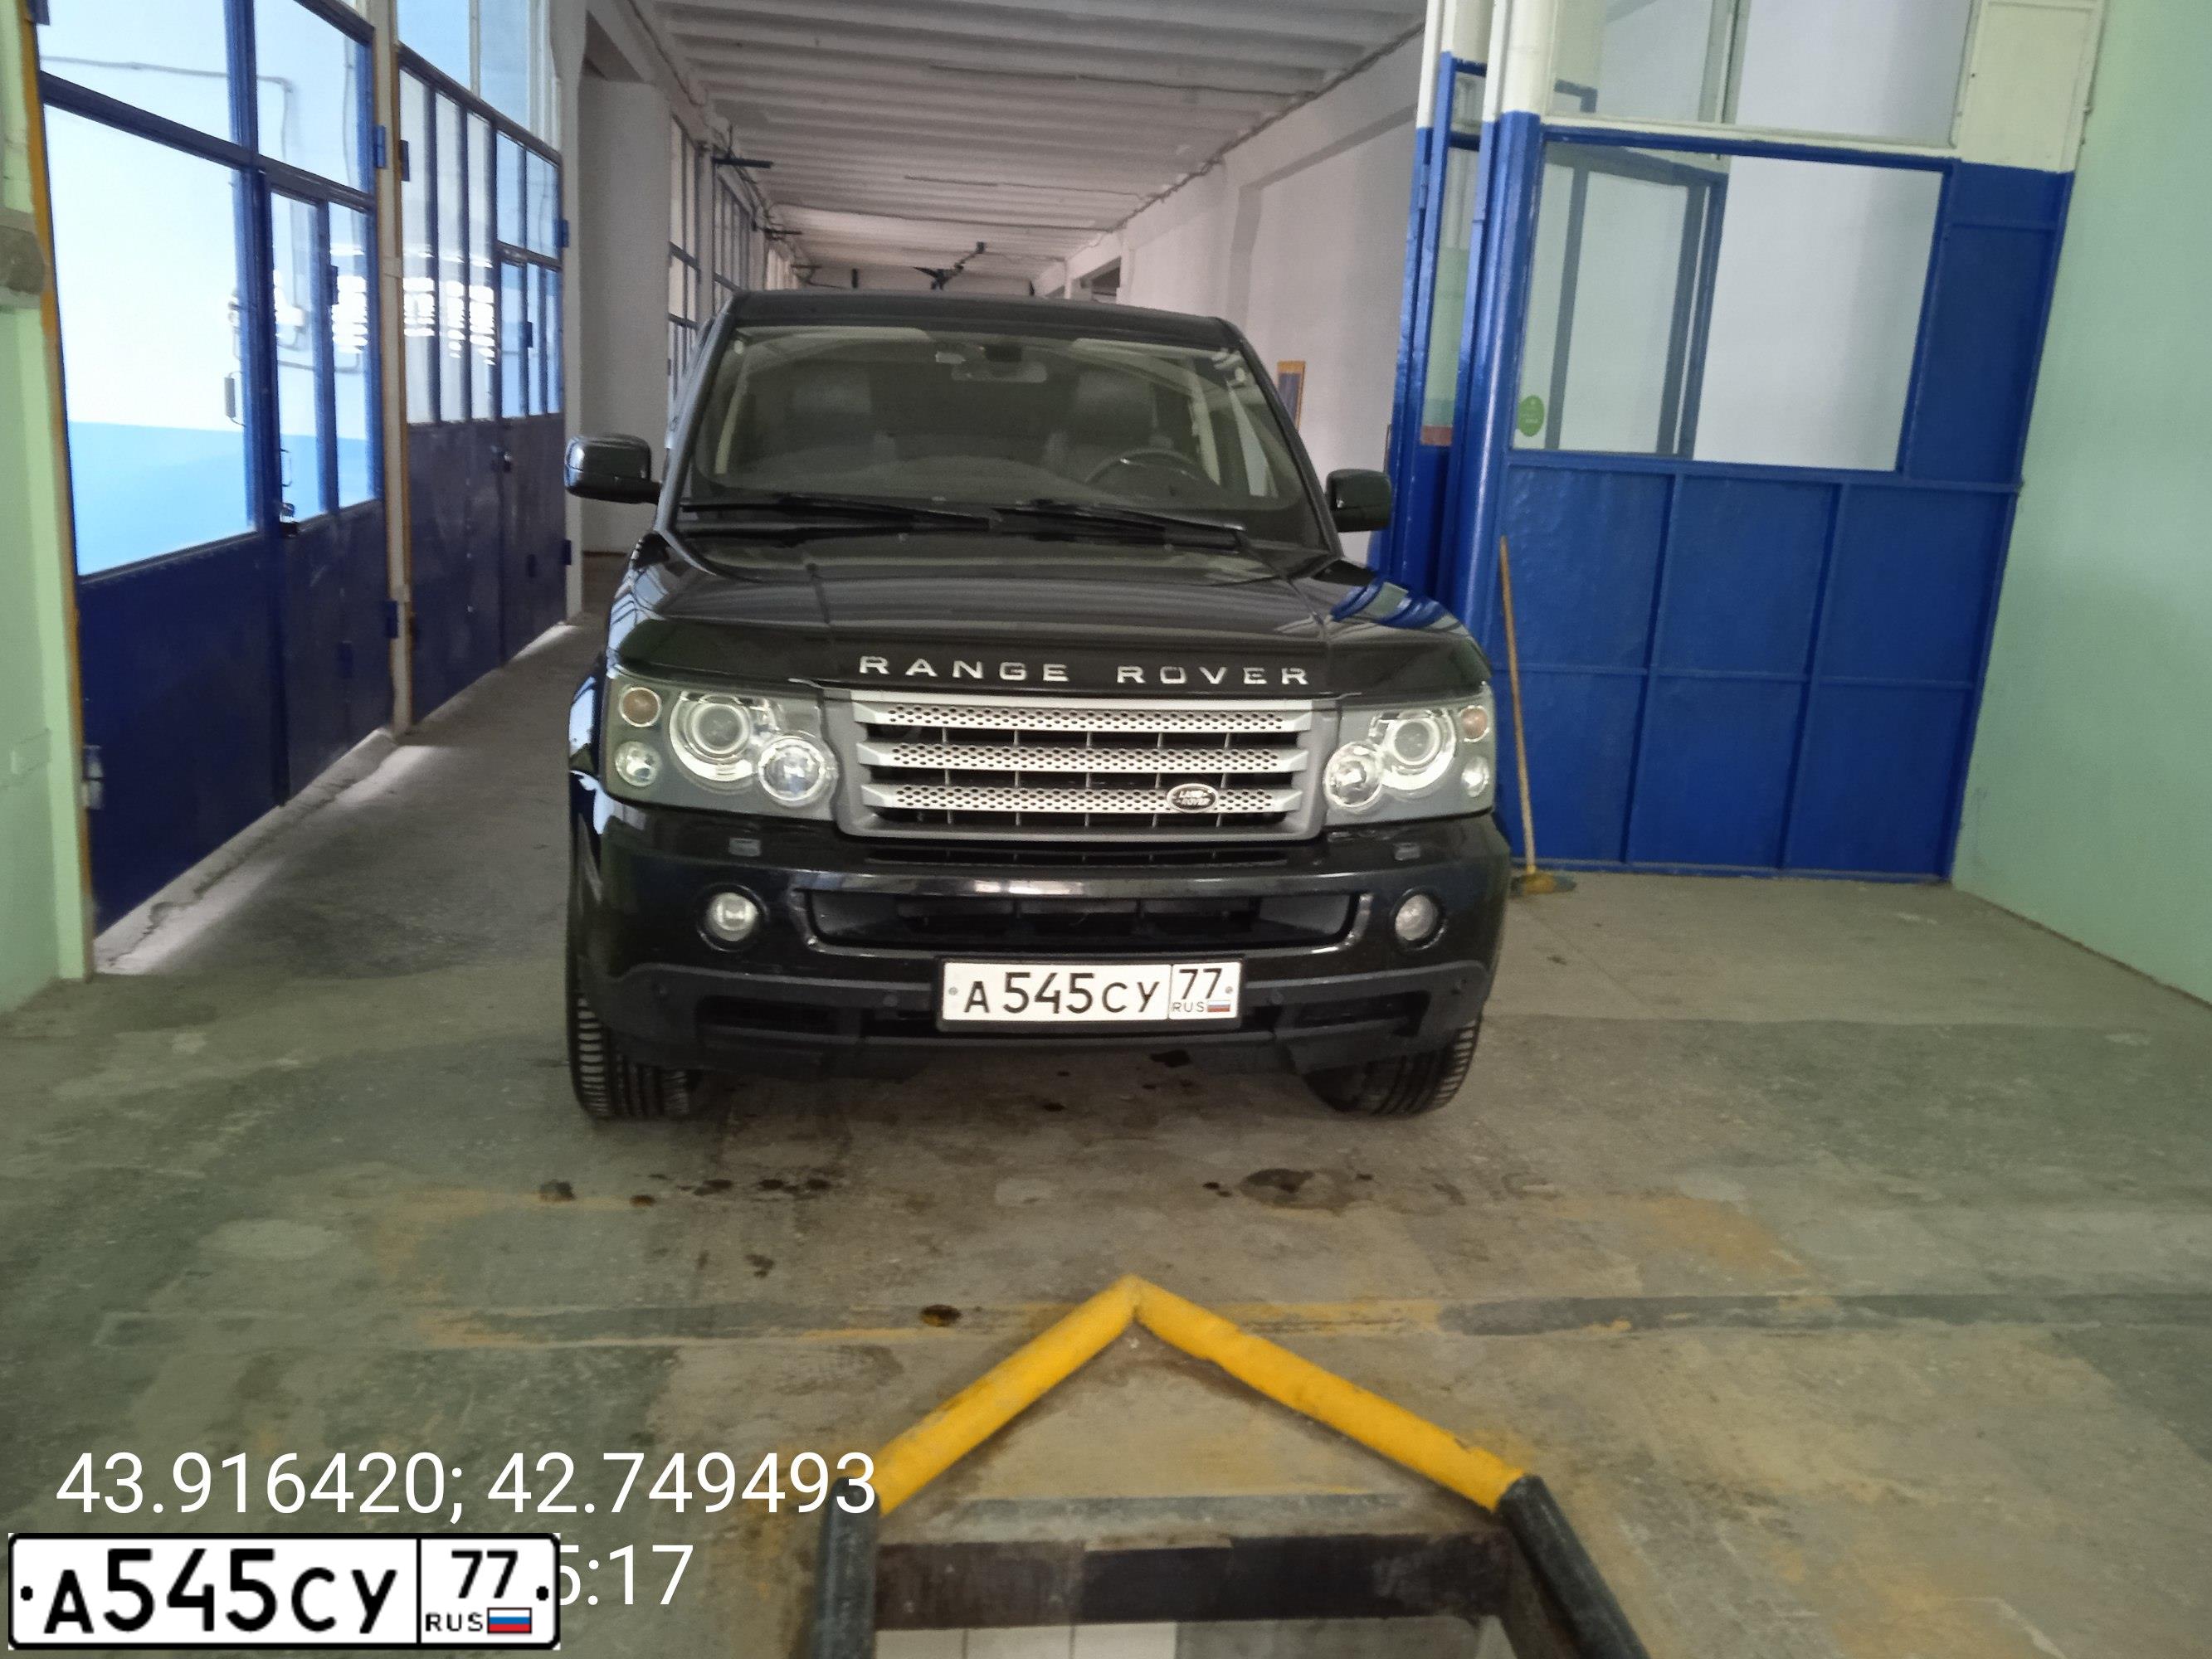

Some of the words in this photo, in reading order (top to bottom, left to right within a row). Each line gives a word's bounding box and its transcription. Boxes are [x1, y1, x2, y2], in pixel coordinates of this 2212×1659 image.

[859, 656, 1069, 682] RANGE
[1117, 666, 1309, 685] ROVER
[963, 971, 1160, 1014] А545СУ
[1178, 967, 1223, 1000] 77
[1172, 1001, 1205, 1013] RUS
